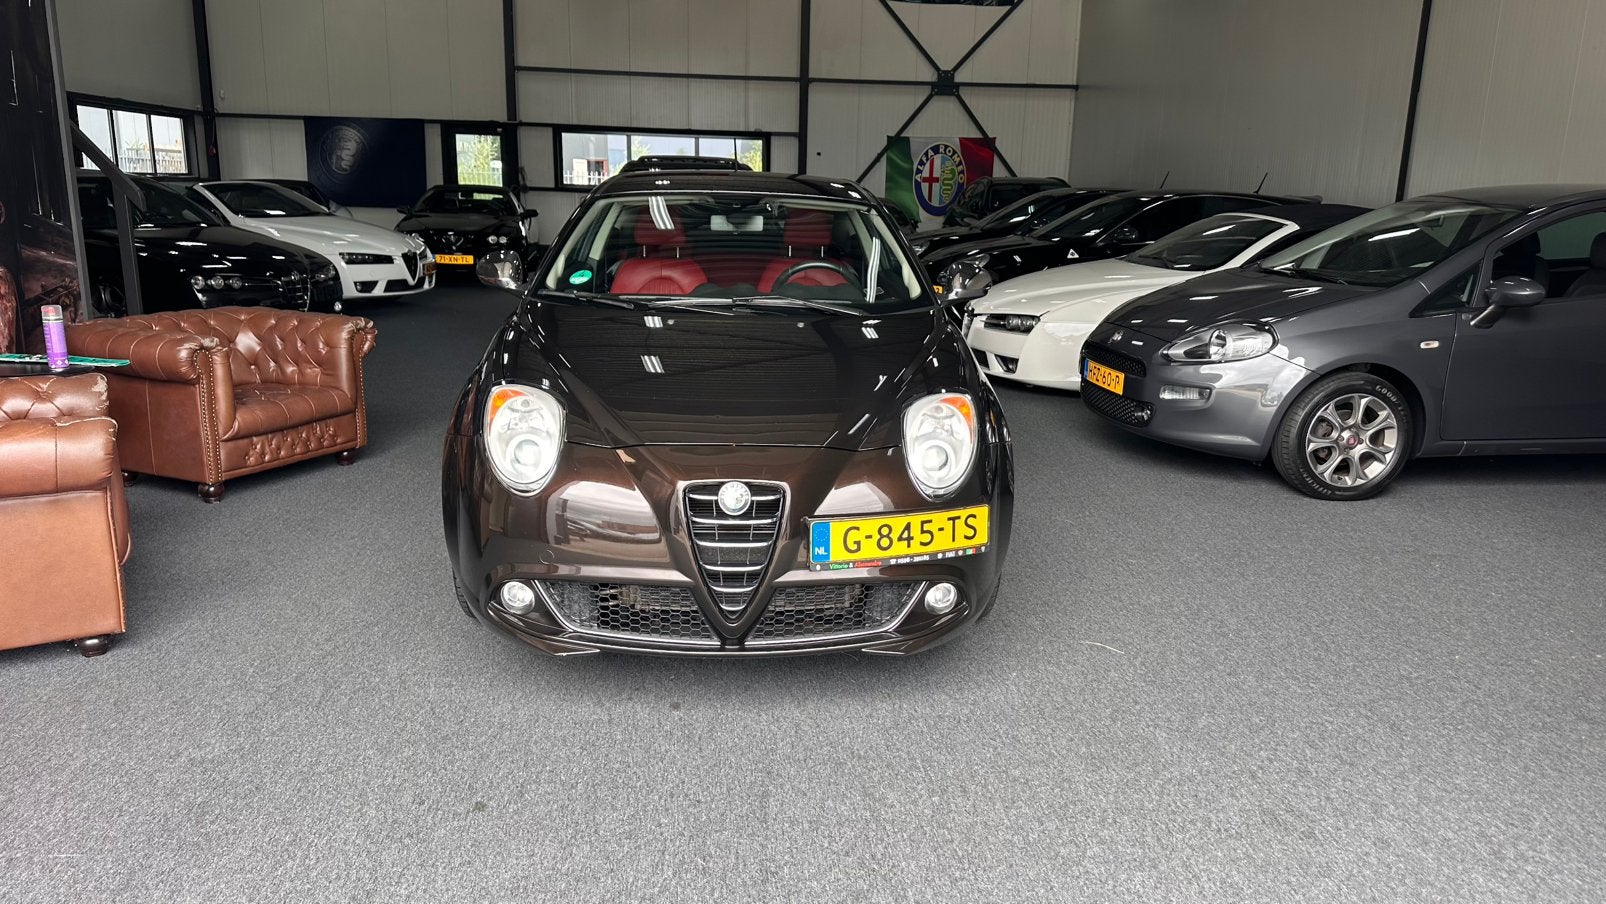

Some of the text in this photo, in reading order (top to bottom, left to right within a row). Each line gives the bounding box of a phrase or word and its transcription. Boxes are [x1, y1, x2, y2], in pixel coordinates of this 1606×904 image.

[915, 144, 965, 184] ALFA ROMEO
[439, 255, 470, 263] 71-XN-TL
[843, 514, 977, 553] G-845-TS
[814, 546, 828, 556] NL
